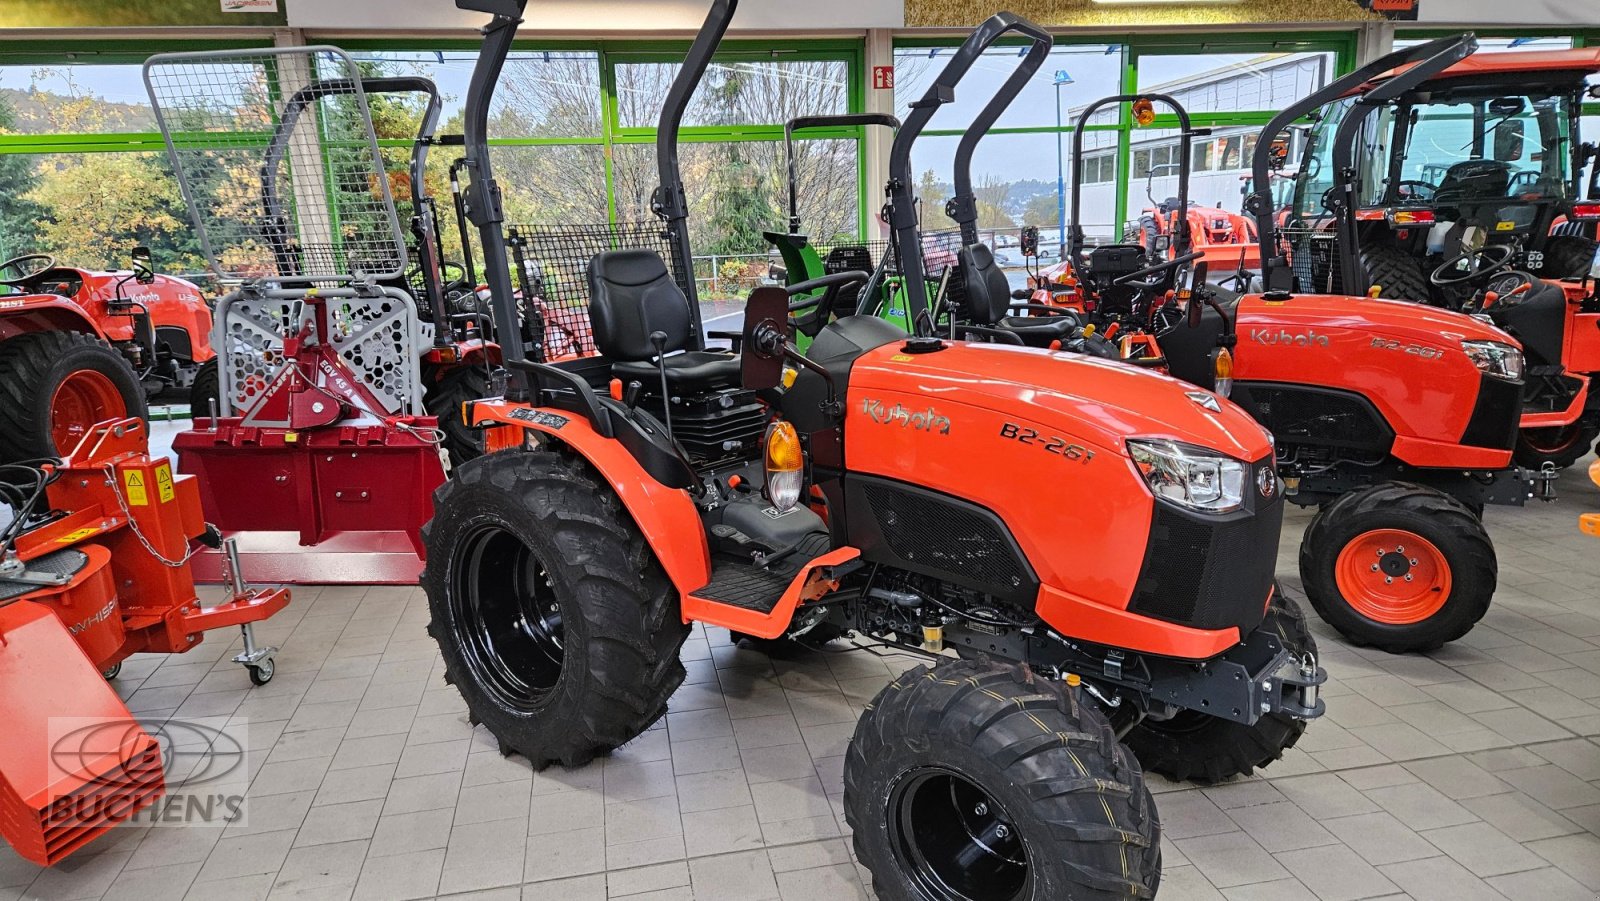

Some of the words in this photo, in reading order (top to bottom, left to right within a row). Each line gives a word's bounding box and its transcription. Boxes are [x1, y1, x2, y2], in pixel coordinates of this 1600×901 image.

[1251, 328, 1329, 347] Kubota
[320, 360, 338, 378] EGV
[335, 377, 347, 389] 45
[343, 389, 353, 398] A
[863, 397, 951, 435] Kubota
[1000, 421, 1096, 465] B2-261
